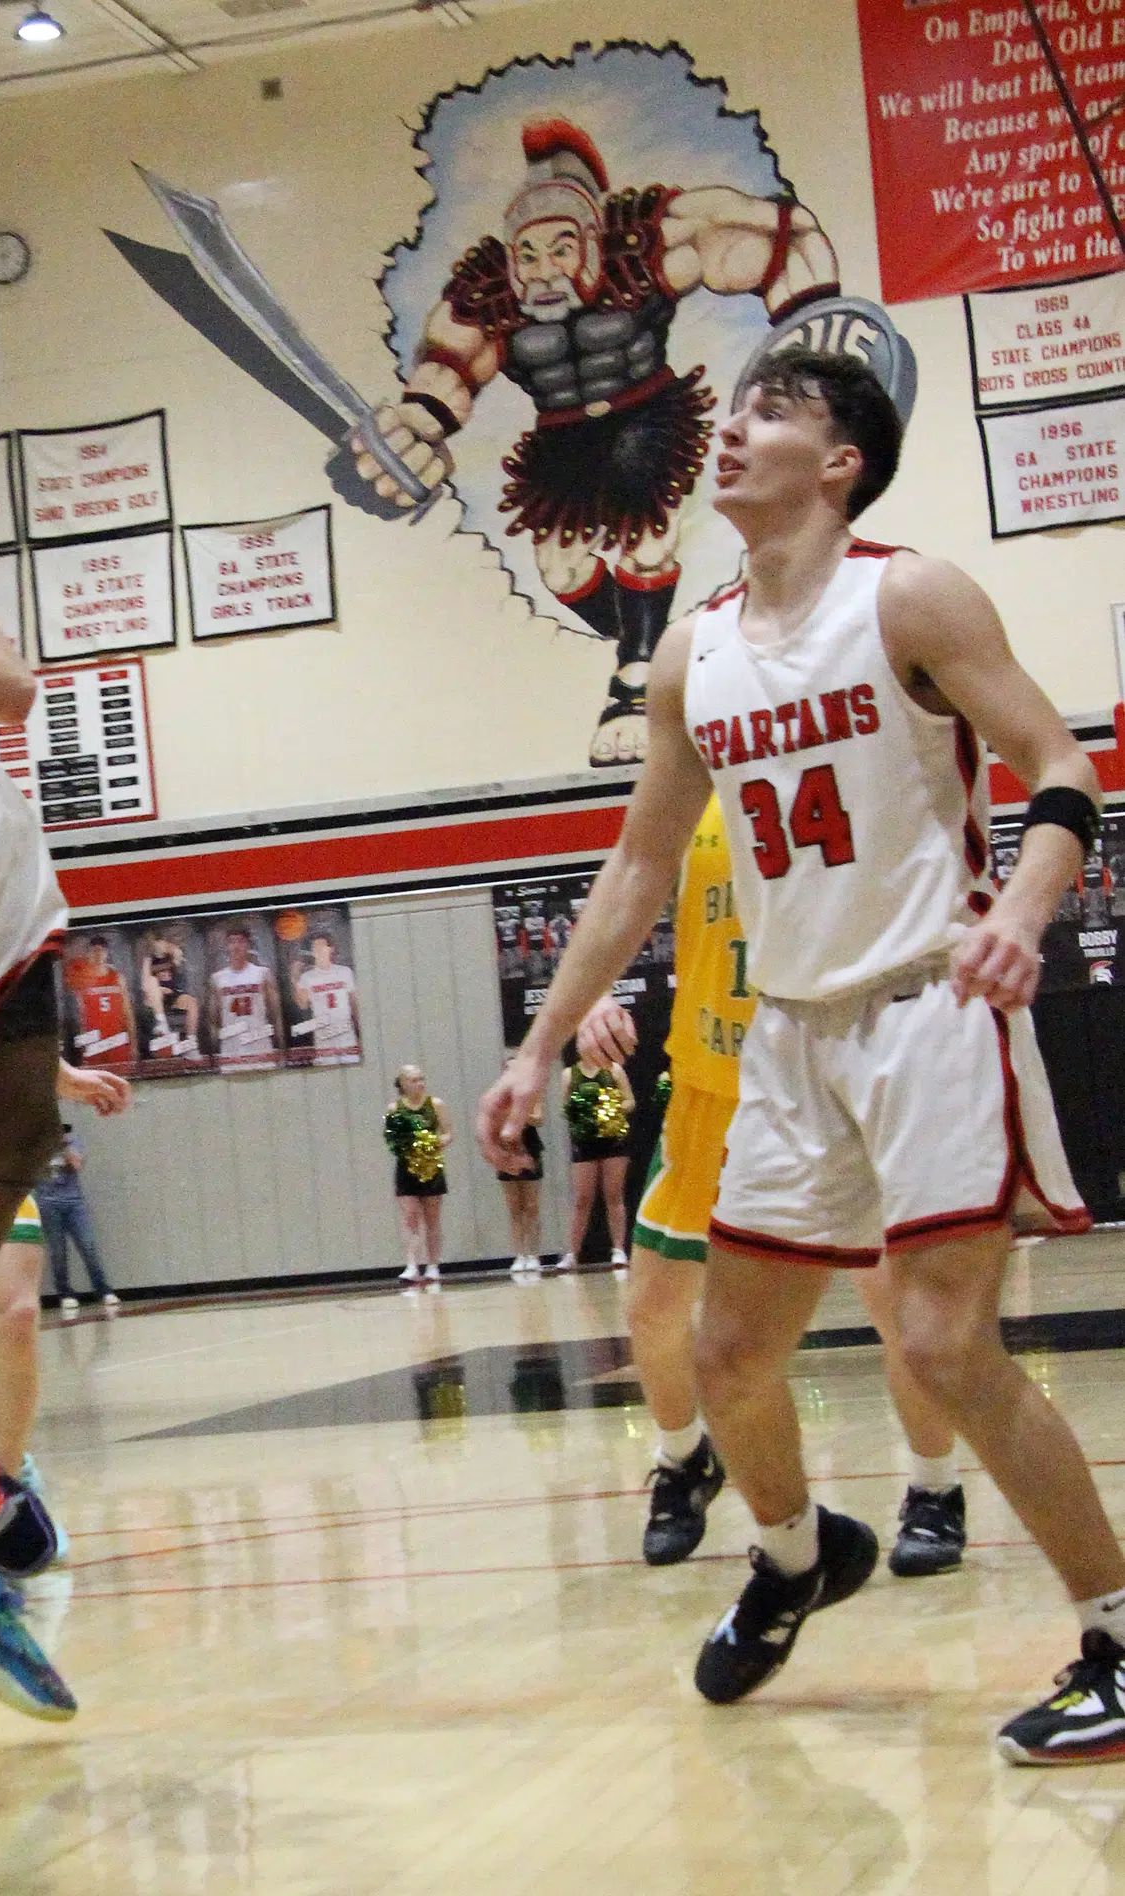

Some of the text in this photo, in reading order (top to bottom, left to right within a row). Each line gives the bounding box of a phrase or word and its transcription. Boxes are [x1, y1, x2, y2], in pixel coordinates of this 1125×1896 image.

[925, 16, 959, 44] On
[1059, 22, 1102, 54] Old
[878, 92, 912, 119] We
[920, 80, 963, 112] will
[972, 75, 1022, 104] beat
[944, 110, 1039, 144] Because
[964, 148, 1011, 178] Any
[1017, 134, 1081, 173] sport
[1088, 124, 1115, 161] of
[931, 181, 994, 213] We're
[1000, 177, 1052, 204] sure
[1058, 171, 1081, 194] to
[976, 214, 1005, 242] So
[1012, 203, 1066, 245] fight
[1073, 203, 1103, 226] on
[997, 230, 1122, 273] To win the
[1016, 315, 1091, 340] CLASS 4A
[991, 332, 1122, 366] STATE CHAMPIONS
[978, 355, 1125, 393] BOYS CROSS COUNT
[1015, 439, 1117, 467] 6A STATE
[81, 463, 150, 488] CHAMPIONS
[1018, 464, 1119, 491] CHAMPIONS
[1021, 487, 1120, 514] WRESTLING
[255, 551, 299, 570] STATE
[96, 573, 145, 593] STATE
[217, 572, 304, 596] CHAMPIONS
[63, 595, 145, 619] CHAMPIONS
[211, 593, 313, 619] GIRLS TRACK
[63, 617, 149, 640] WRESTLING
[694, 684, 881, 770] SPARTANS
[740, 763, 856, 881] 34
